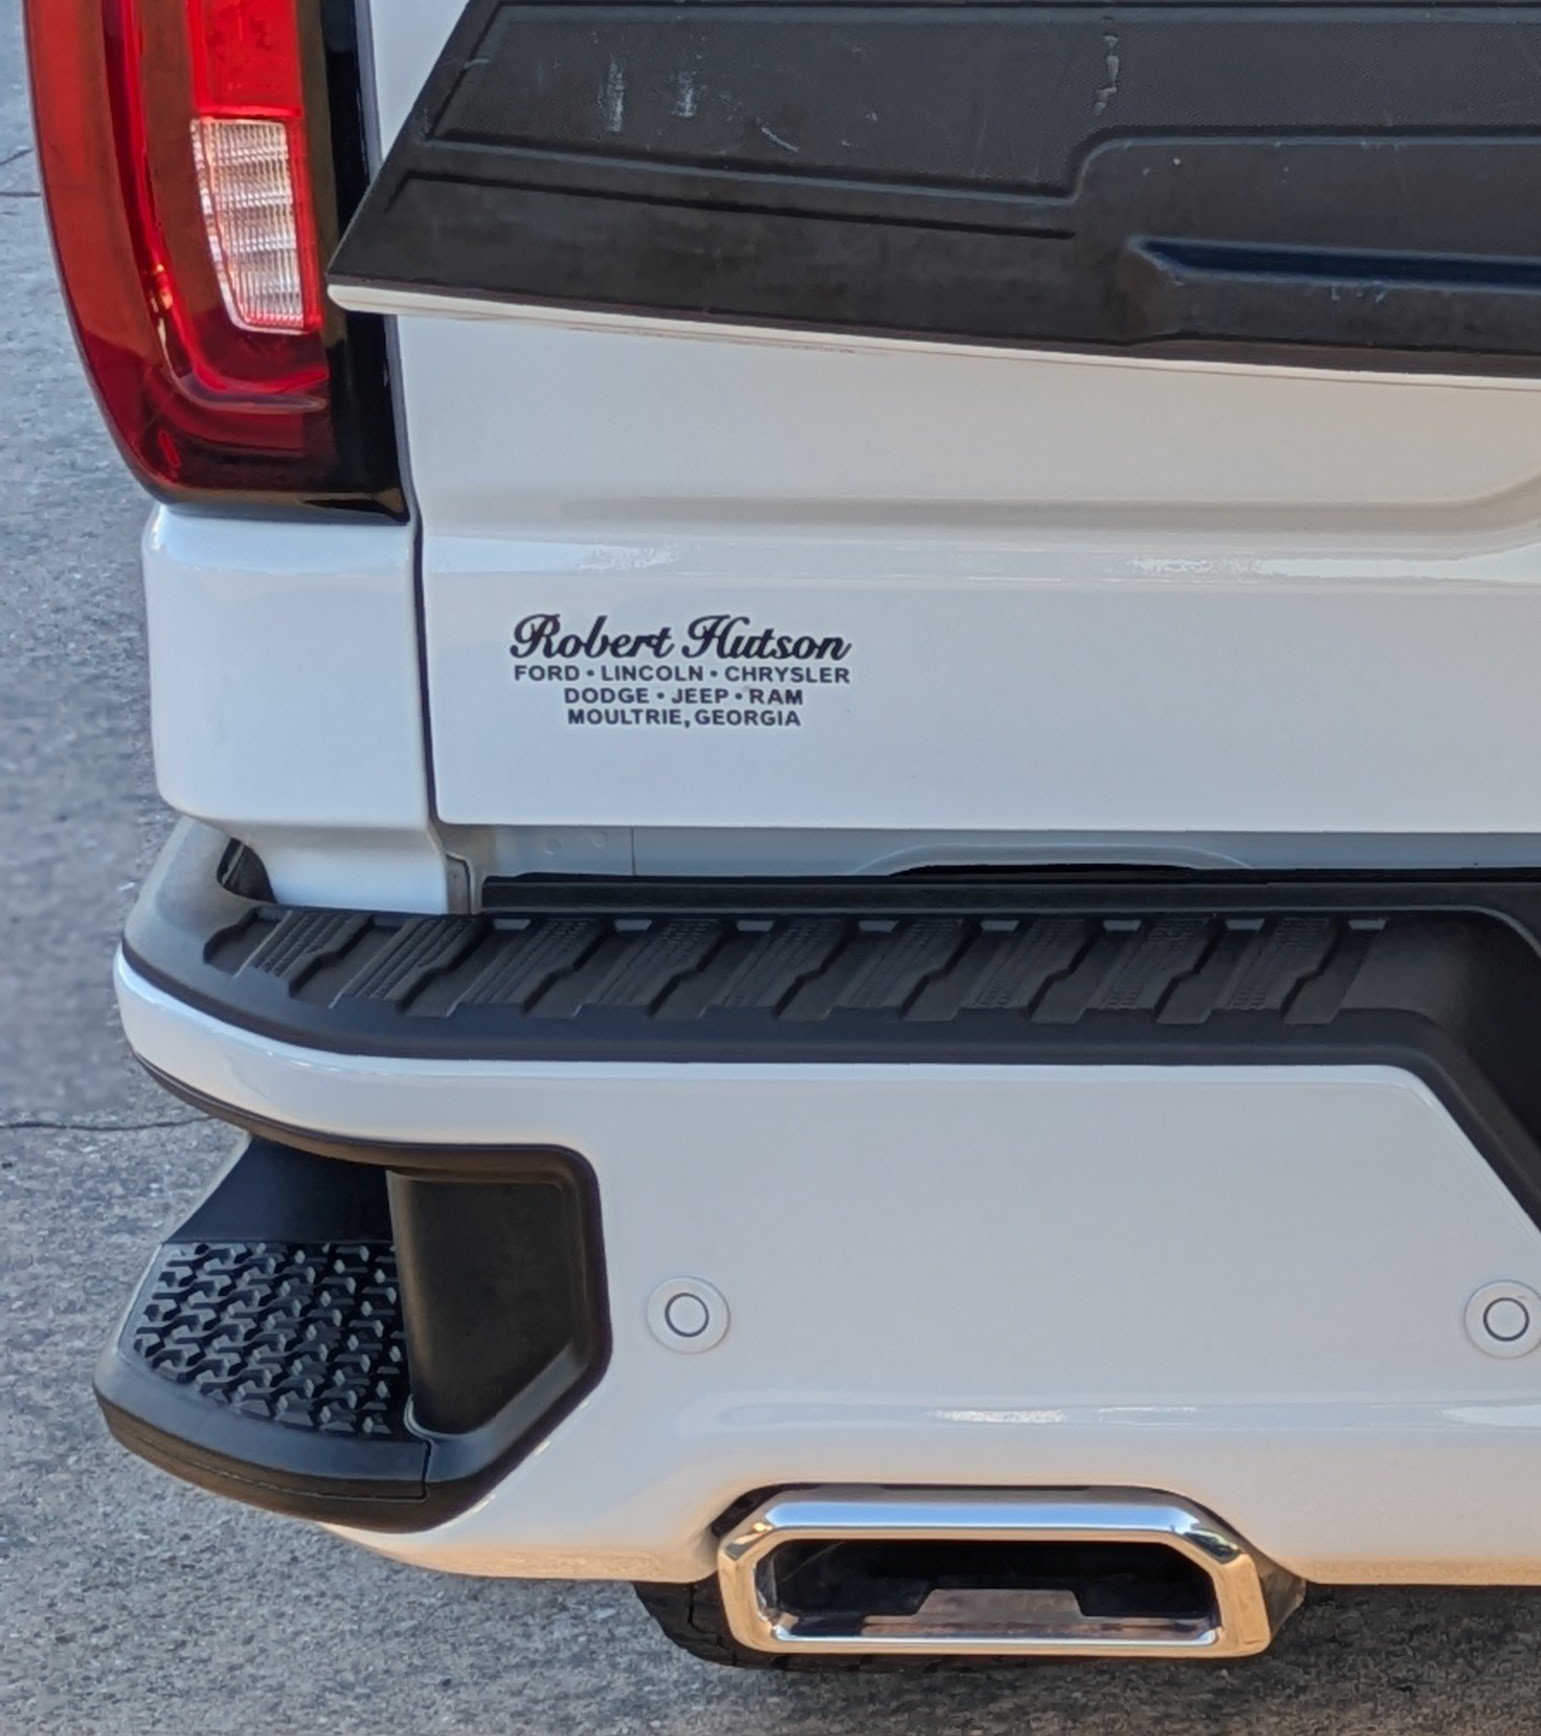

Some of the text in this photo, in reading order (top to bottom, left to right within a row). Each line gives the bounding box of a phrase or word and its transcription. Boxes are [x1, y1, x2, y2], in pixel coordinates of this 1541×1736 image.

[510, 613, 853, 661] Robert Hutson
[724, 667, 850, 684] CHRYSLER
[564, 688, 803, 705] DODGE JEEP RAM
[567, 709, 802, 727] MOULTRIE, GEORGIA
